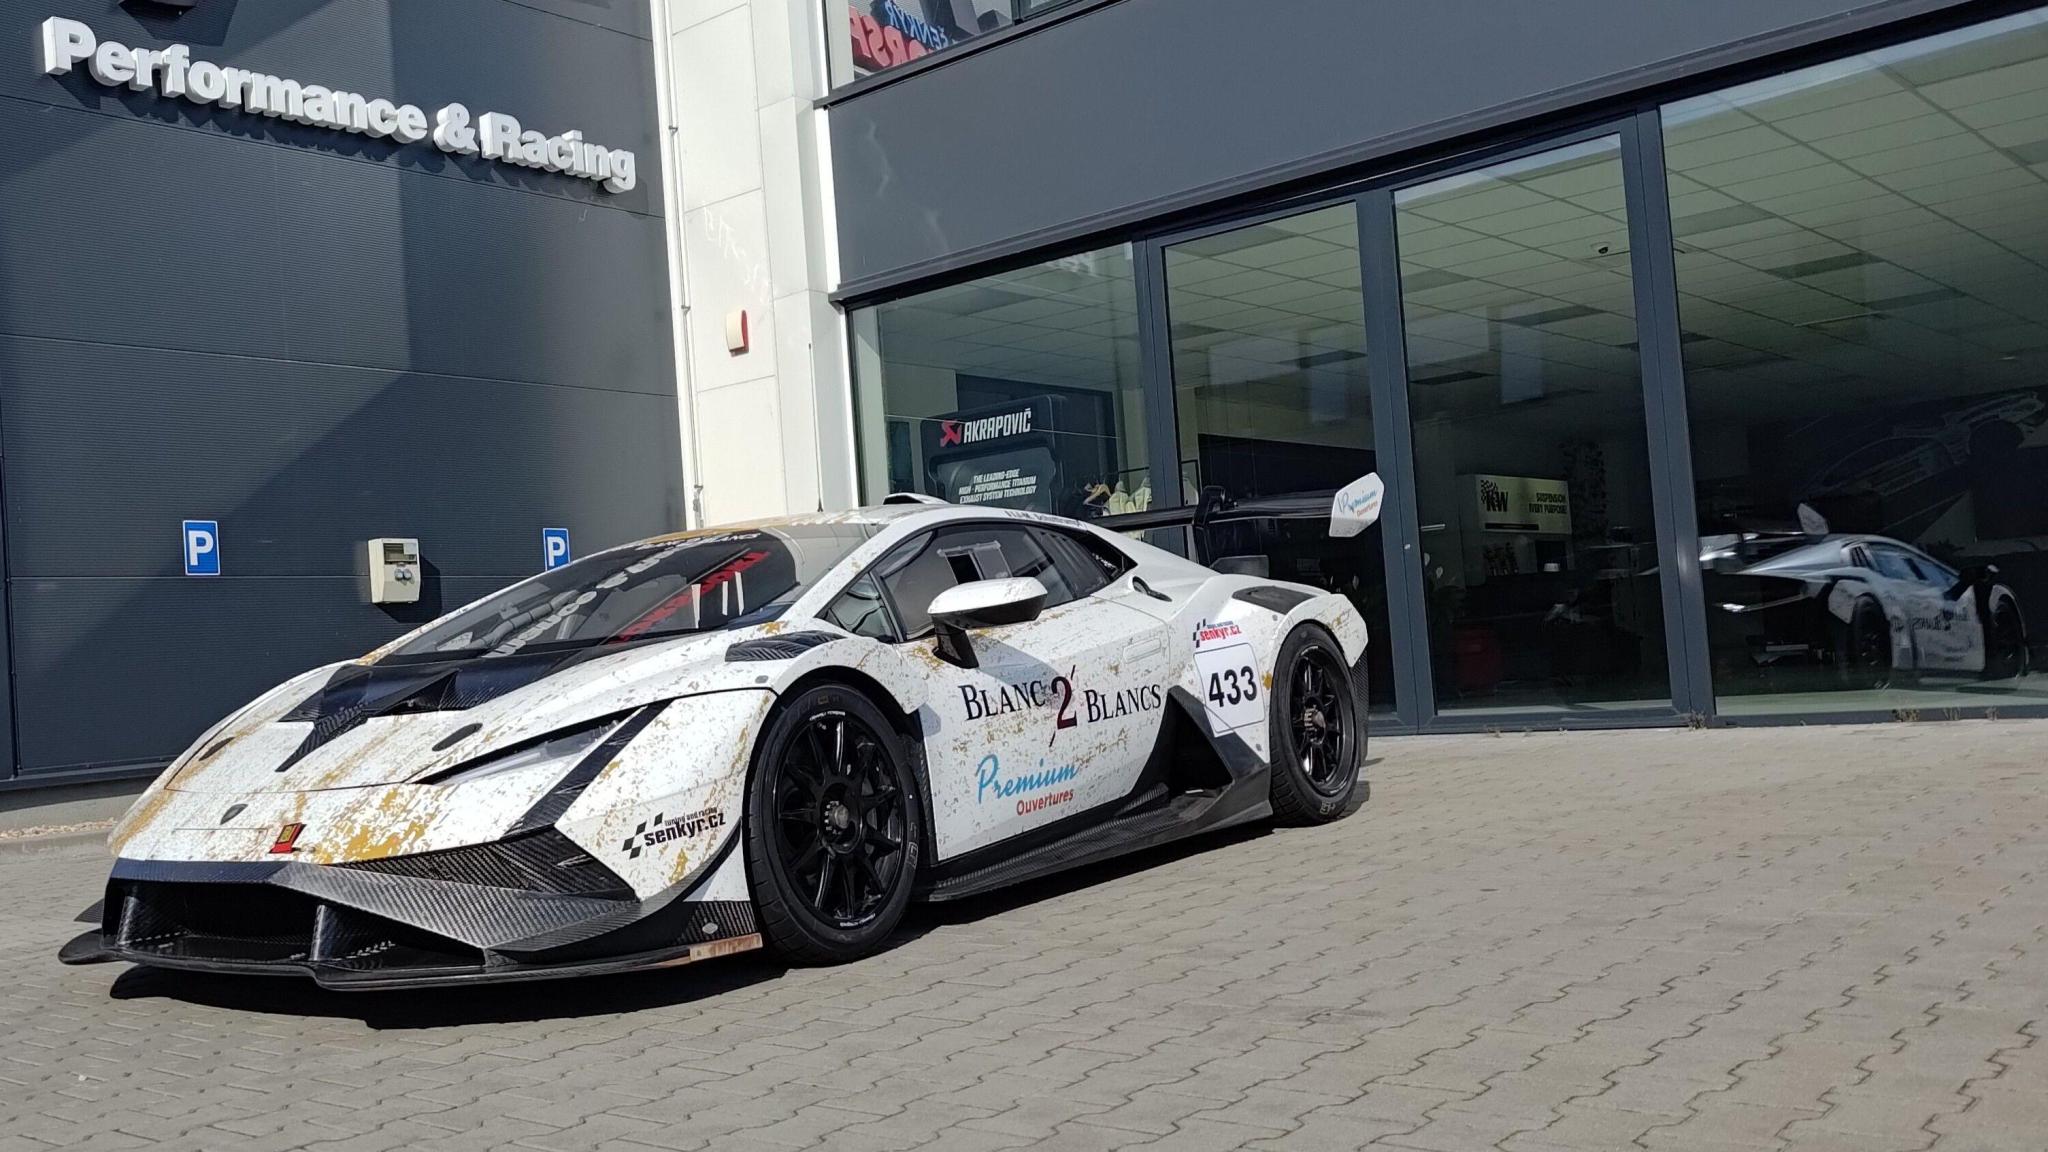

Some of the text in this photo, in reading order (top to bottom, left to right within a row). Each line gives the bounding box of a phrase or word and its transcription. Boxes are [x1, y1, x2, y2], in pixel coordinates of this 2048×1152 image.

[42, 15, 636, 193] Performance & Racing
[963, 408, 1031, 444] AKRAPOVIČ
[188, 530, 214, 566] P
[547, 537, 566, 566] P
[1200, 624, 1242, 642] senkyr.cz
[958, 676, 1162, 730] BLANC 2 BLANCS
[1208, 665, 1258, 708] 433
[975, 753, 1080, 806] Premium
[686, 810, 698, 819] and
[1016, 788, 1074, 817] Ouvertures
[644, 812, 726, 847] senkyr.cz
